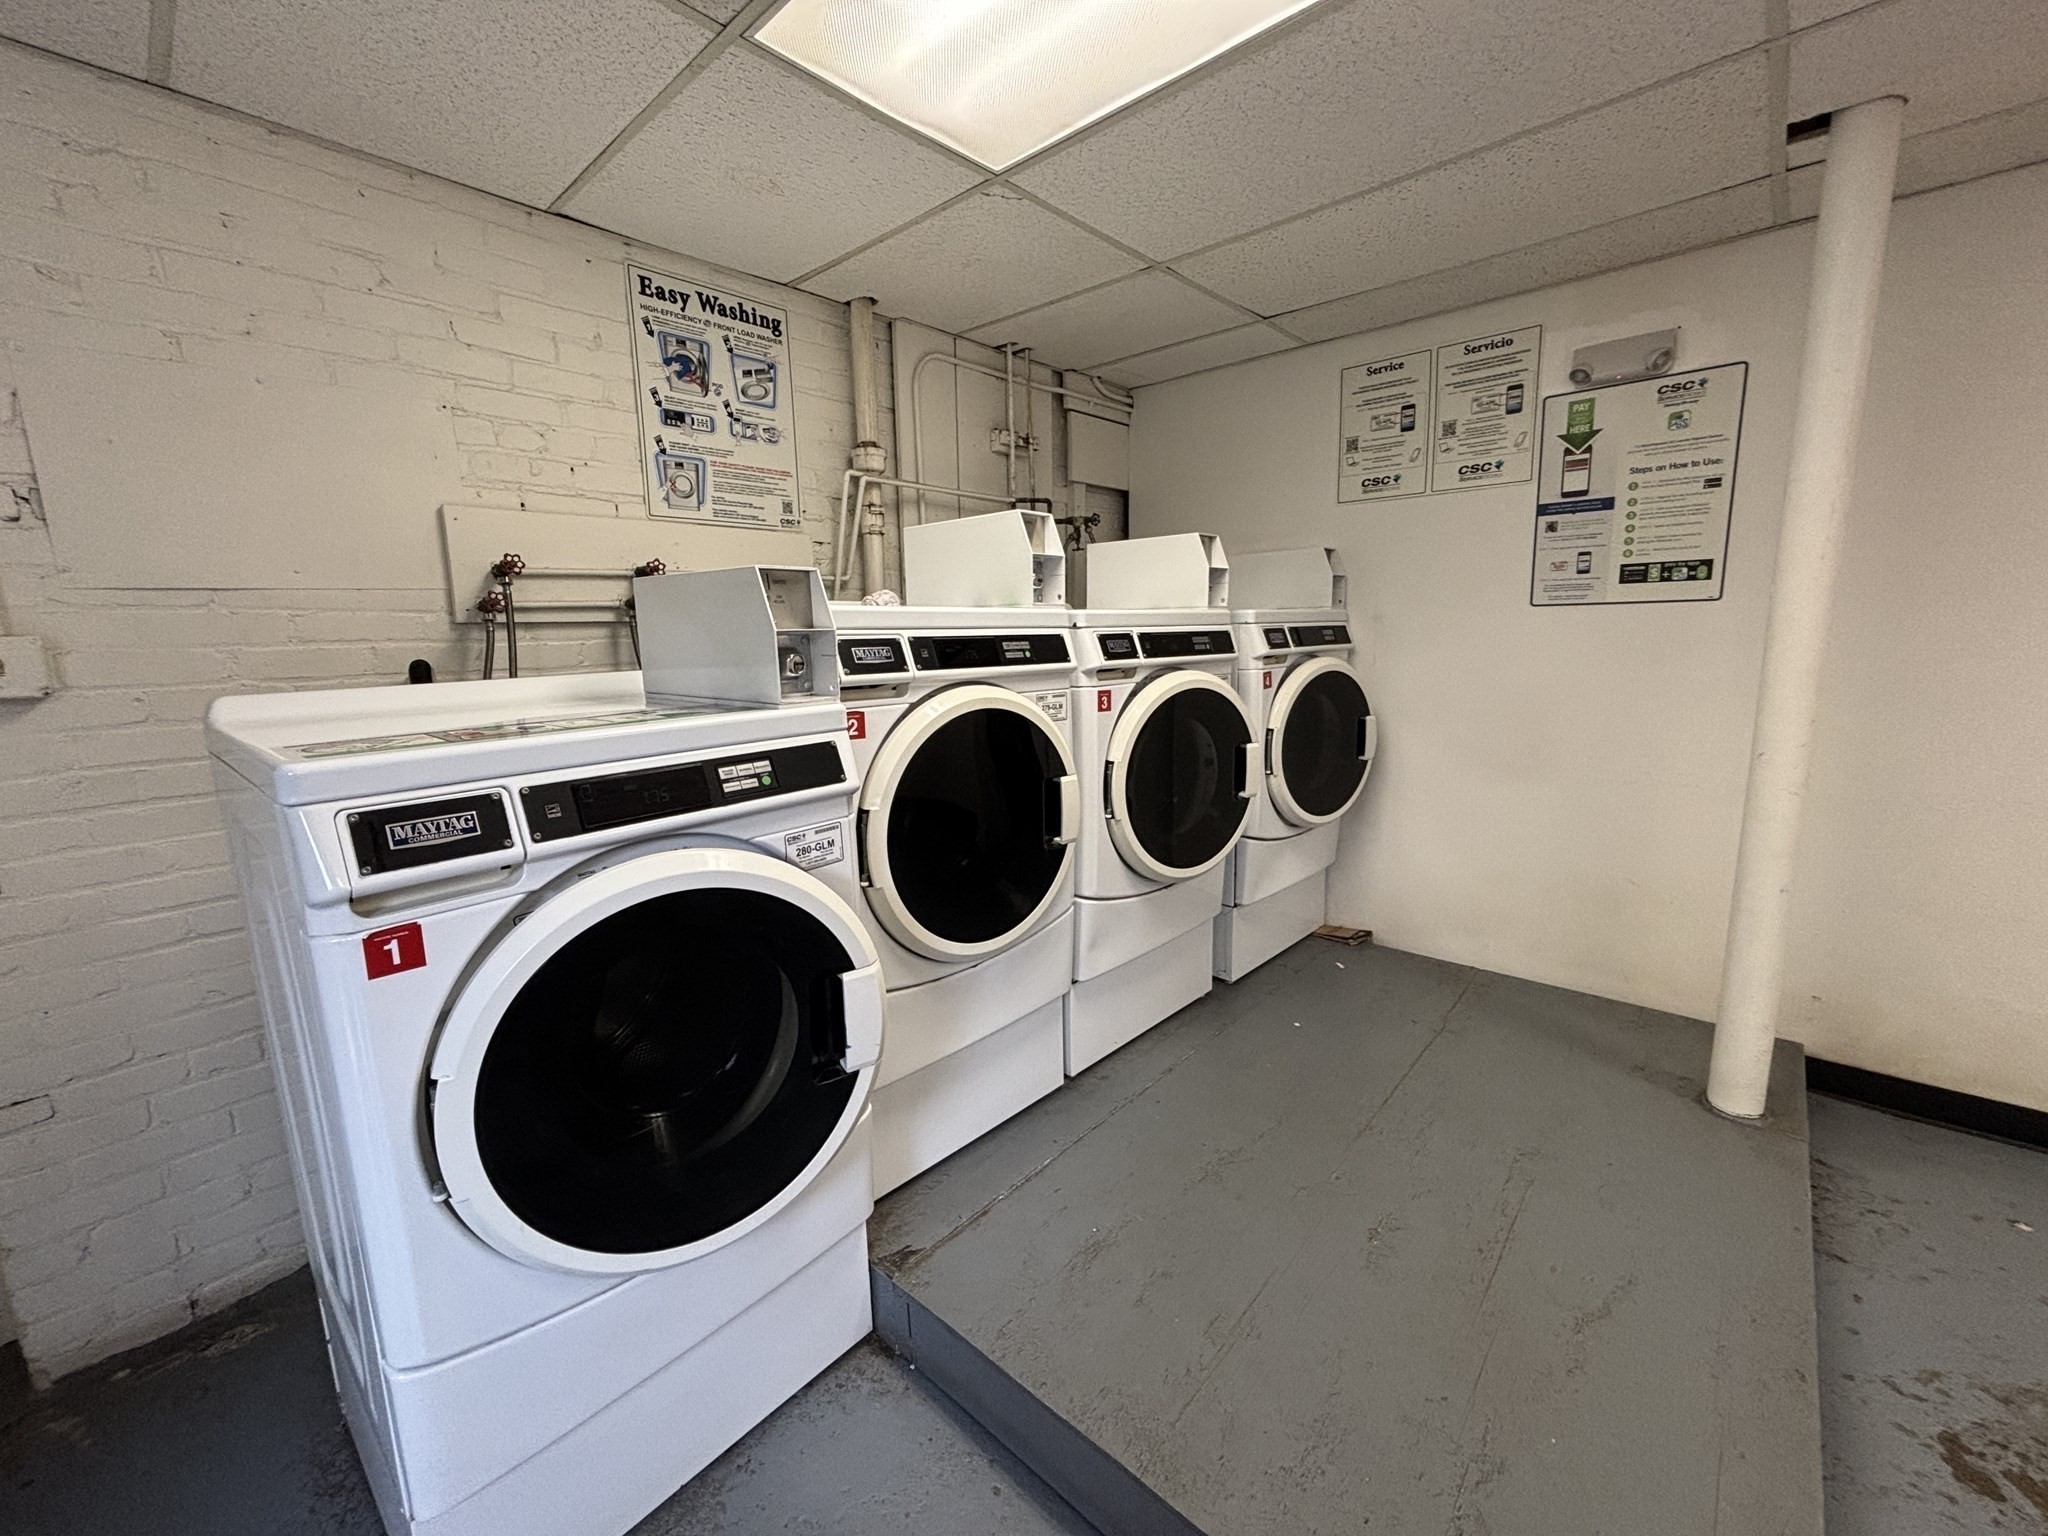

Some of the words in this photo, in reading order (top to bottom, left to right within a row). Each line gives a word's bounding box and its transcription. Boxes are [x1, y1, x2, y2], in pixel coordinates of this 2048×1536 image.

[637, 274, 691, 312] Easy
[695, 290, 782, 338] Washing
[639, 302, 703, 325] HIGH-EFFICIENCY
[713, 322, 736, 334] FRONT
[737, 328, 756, 339] LOAD
[756, 333, 783, 346] WASHER
[1463, 337, 1514, 355] Servicio
[1366, 362, 1405, 376] Service
[1657, 380, 1696, 395] CSC
[653, 394, 660, 402] 3
[1572, 402, 1590, 413] PAY
[1569, 424, 1590, 434] HERE
[1458, 462, 1492, 475] CSC
[1629, 466, 1653, 474] Steps
[1655, 464, 1666, 472] on
[1669, 461, 1688, 470] How
[1691, 459, 1700, 468] to
[1702, 457, 1724, 466] Use:
[1361, 476, 1392, 487] CSC
[853, 649, 891, 657] MAYTAG
[1101, 696, 1108, 709] 3
[848, 718, 859, 736] 2
[391, 815, 474, 842] MAYTAG
[407, 828, 464, 844] COMMERCIAL
[787, 834, 802, 843] CSC
[796, 838, 835, 858] 280-GLM
[383, 938, 401, 966] 1
